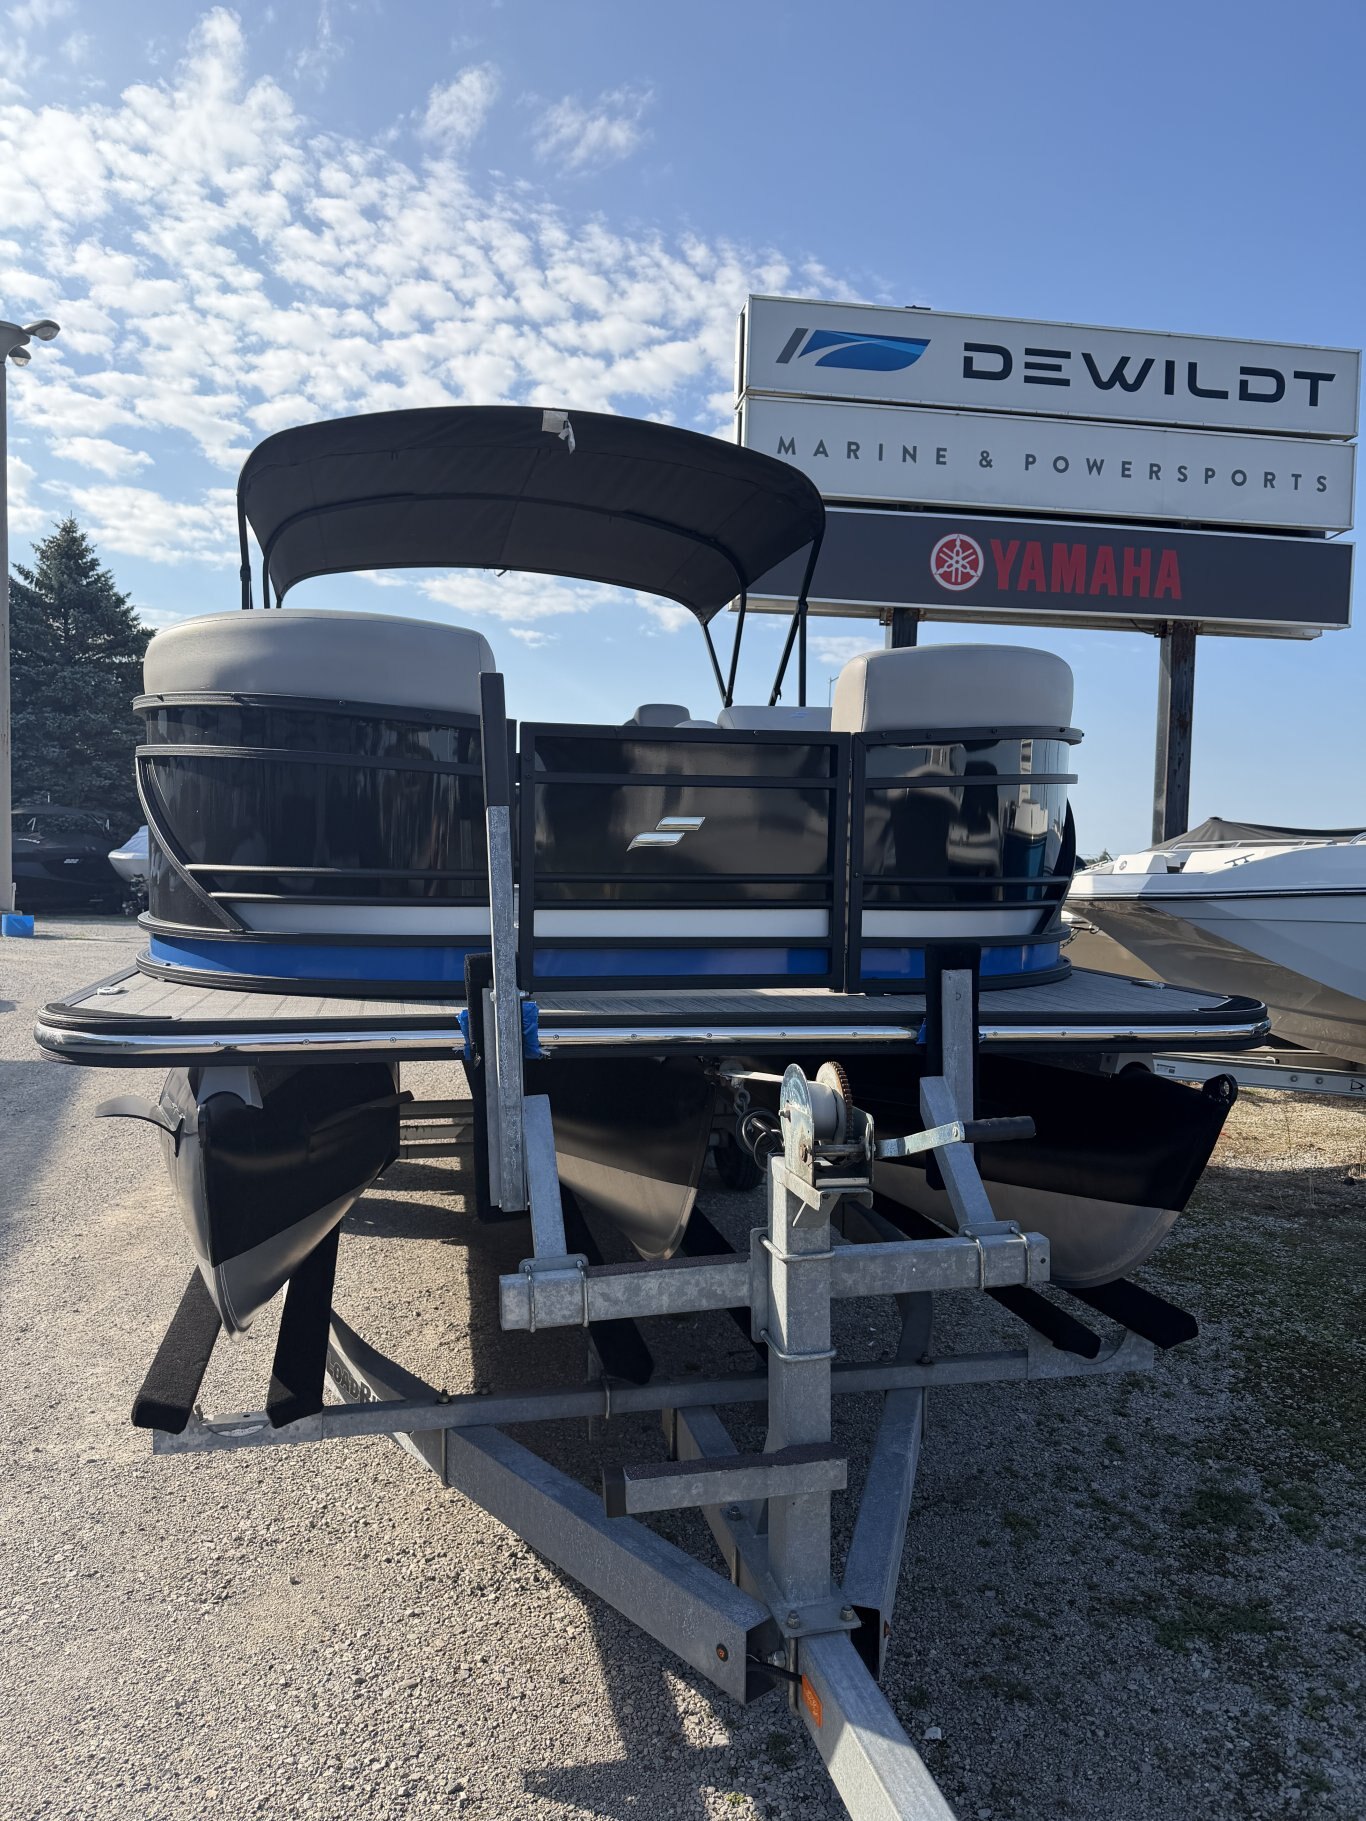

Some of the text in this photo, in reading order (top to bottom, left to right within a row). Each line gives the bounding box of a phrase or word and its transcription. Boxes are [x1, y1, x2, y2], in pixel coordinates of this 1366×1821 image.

[963, 341, 1337, 407] DEWILDT
[776, 435, 1328, 493] MARINE & POWERSPORTS
[990, 538, 1183, 600] YAMAHA
